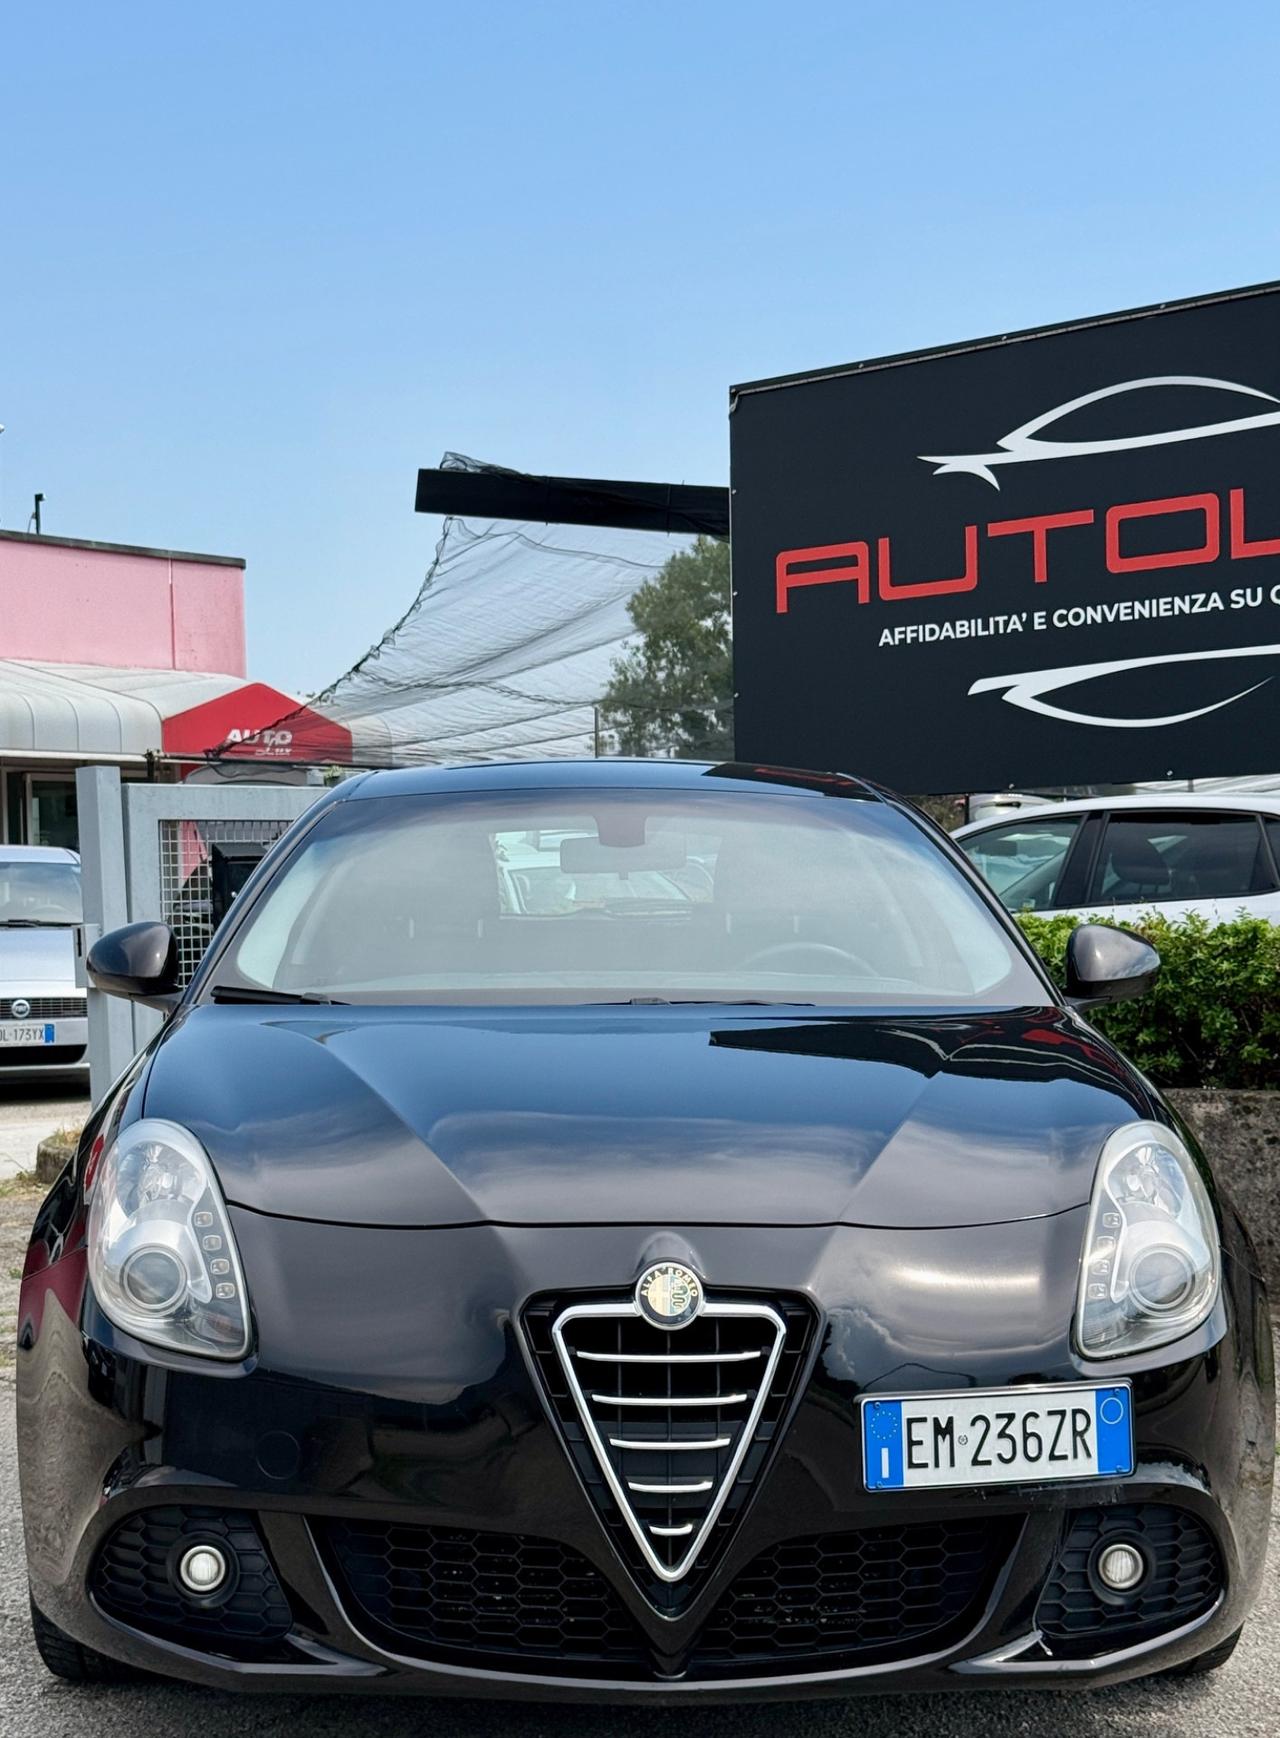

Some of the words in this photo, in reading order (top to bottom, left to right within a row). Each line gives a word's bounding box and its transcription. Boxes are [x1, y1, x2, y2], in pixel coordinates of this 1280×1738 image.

[1033, 611, 1047, 630] E
[1052, 591, 1225, 628] CONVENIENZA
[1230, 586, 1263, 609] SU
[227, 729, 293, 745] AUTO
[13, 1028, 44, 1041] 173YX
[667, 1267, 698, 1297] ROMEO
[906, 1416, 956, 1469] EM
[970, 1408, 1092, 1467] 236ZR
[881, 1447, 890, 1479] I
